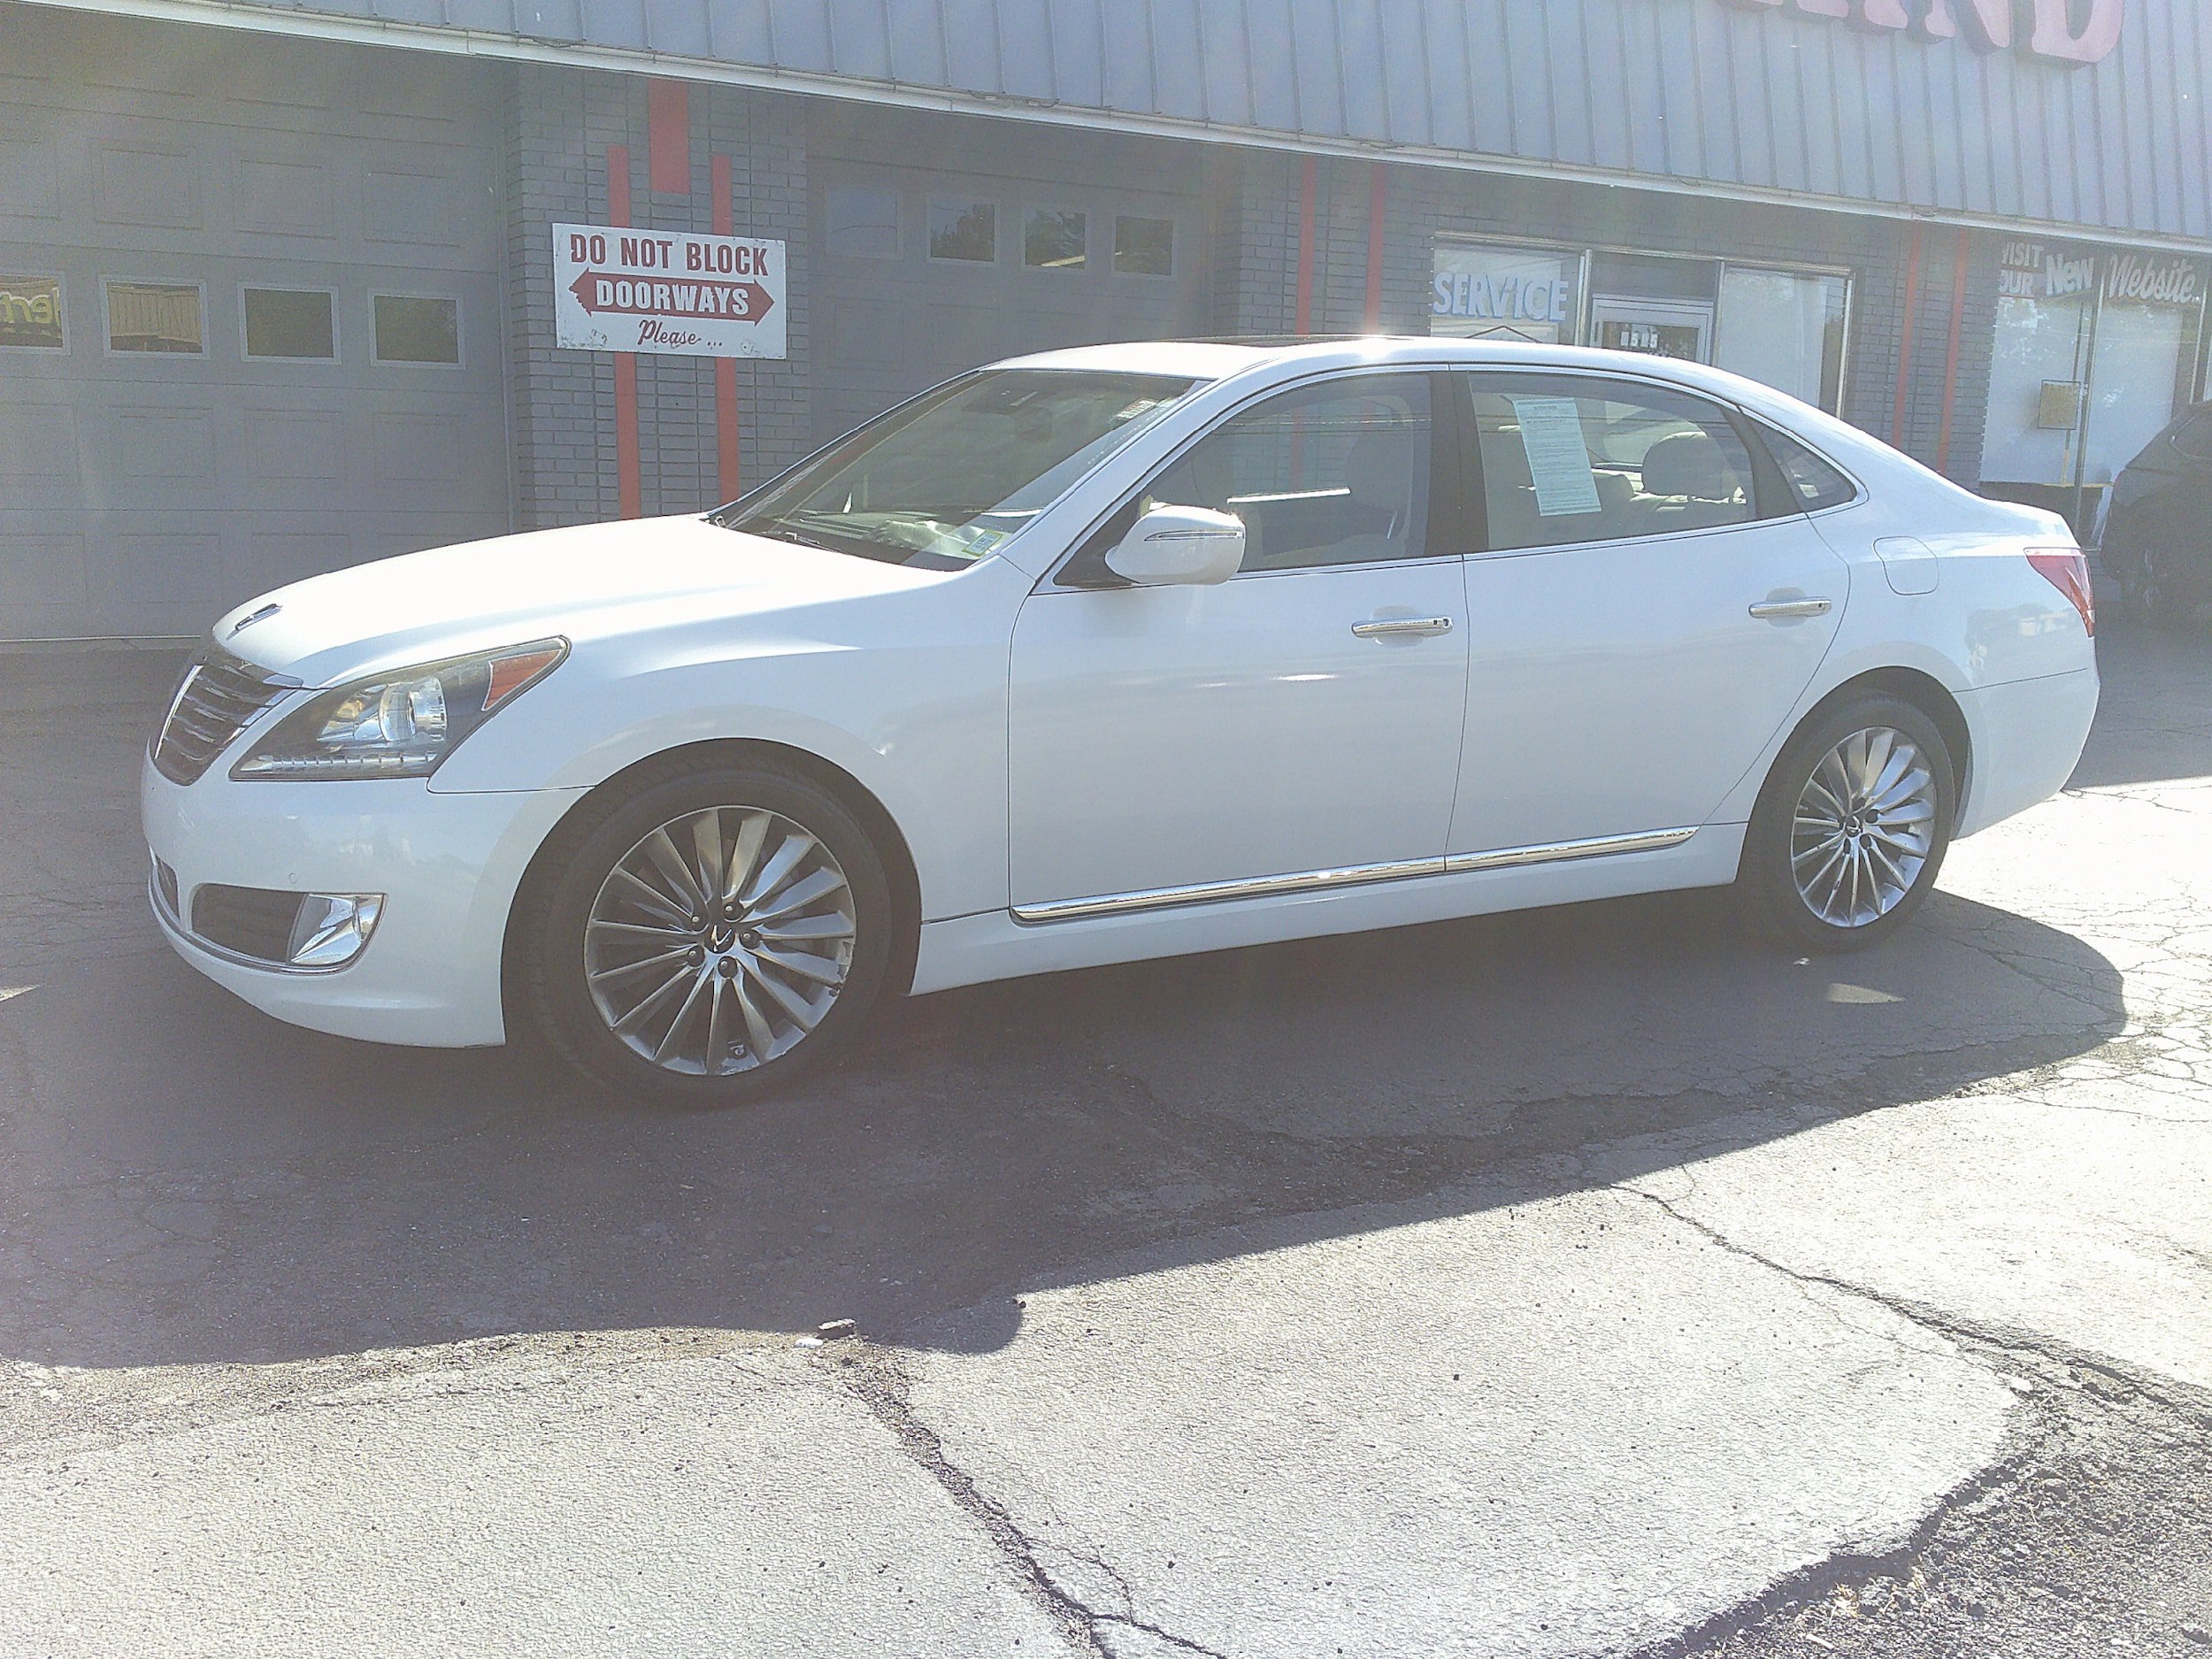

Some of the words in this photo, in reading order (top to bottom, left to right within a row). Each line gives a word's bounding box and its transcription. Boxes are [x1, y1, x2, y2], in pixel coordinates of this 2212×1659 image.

[570, 234, 606, 265] DO
[620, 237, 672, 269] NOT
[686, 242, 769, 276] BLOCK
[595, 280, 749, 315] DOORWAYS
[1432, 271, 1569, 321] SERVICE
[637, 319, 702, 345] Please
